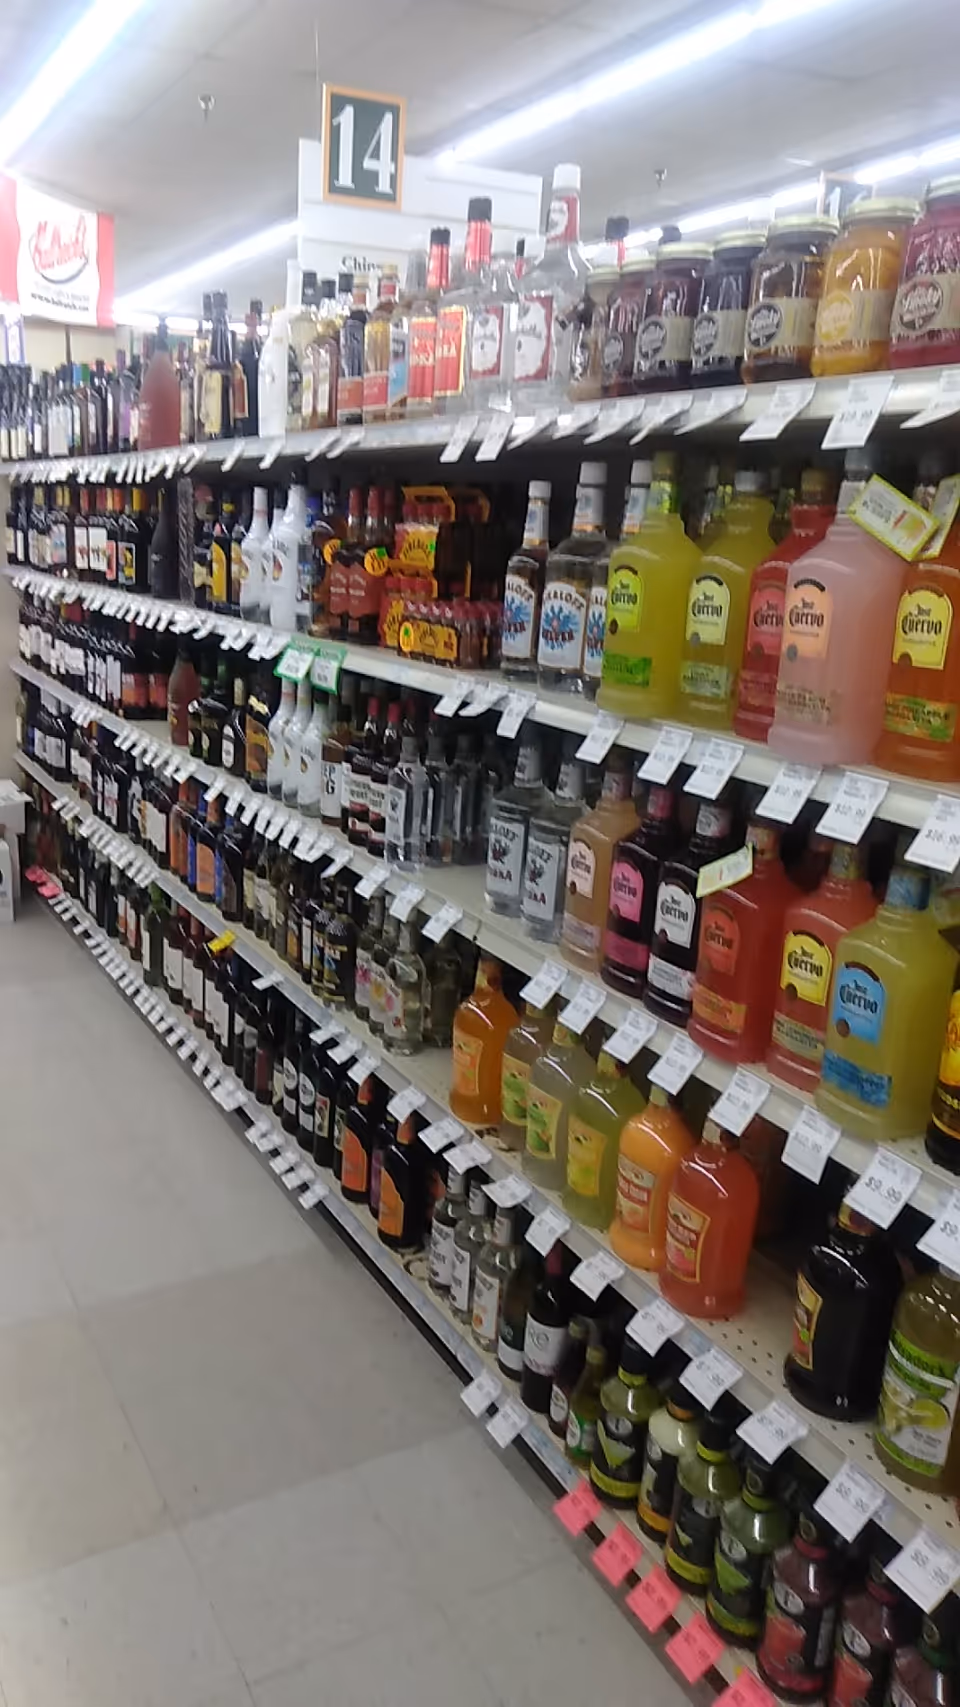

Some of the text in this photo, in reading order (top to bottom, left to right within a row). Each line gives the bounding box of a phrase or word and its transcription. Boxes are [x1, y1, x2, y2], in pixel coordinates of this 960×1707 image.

[332, 104, 395, 194] 14
[611, 588, 638, 606] Cuervo
[691, 600, 722, 618] Cuervo
[789, 609, 825, 628] Cuervo
[901, 616, 942, 636] Cuervo
[613, 878, 638, 899] Cuervo
[659, 903, 689, 923] Cuervo
[704, 927, 734, 950] Cuervo
[787, 952, 824, 978] Cuervo
[839, 984, 879, 1014] Cuervo
